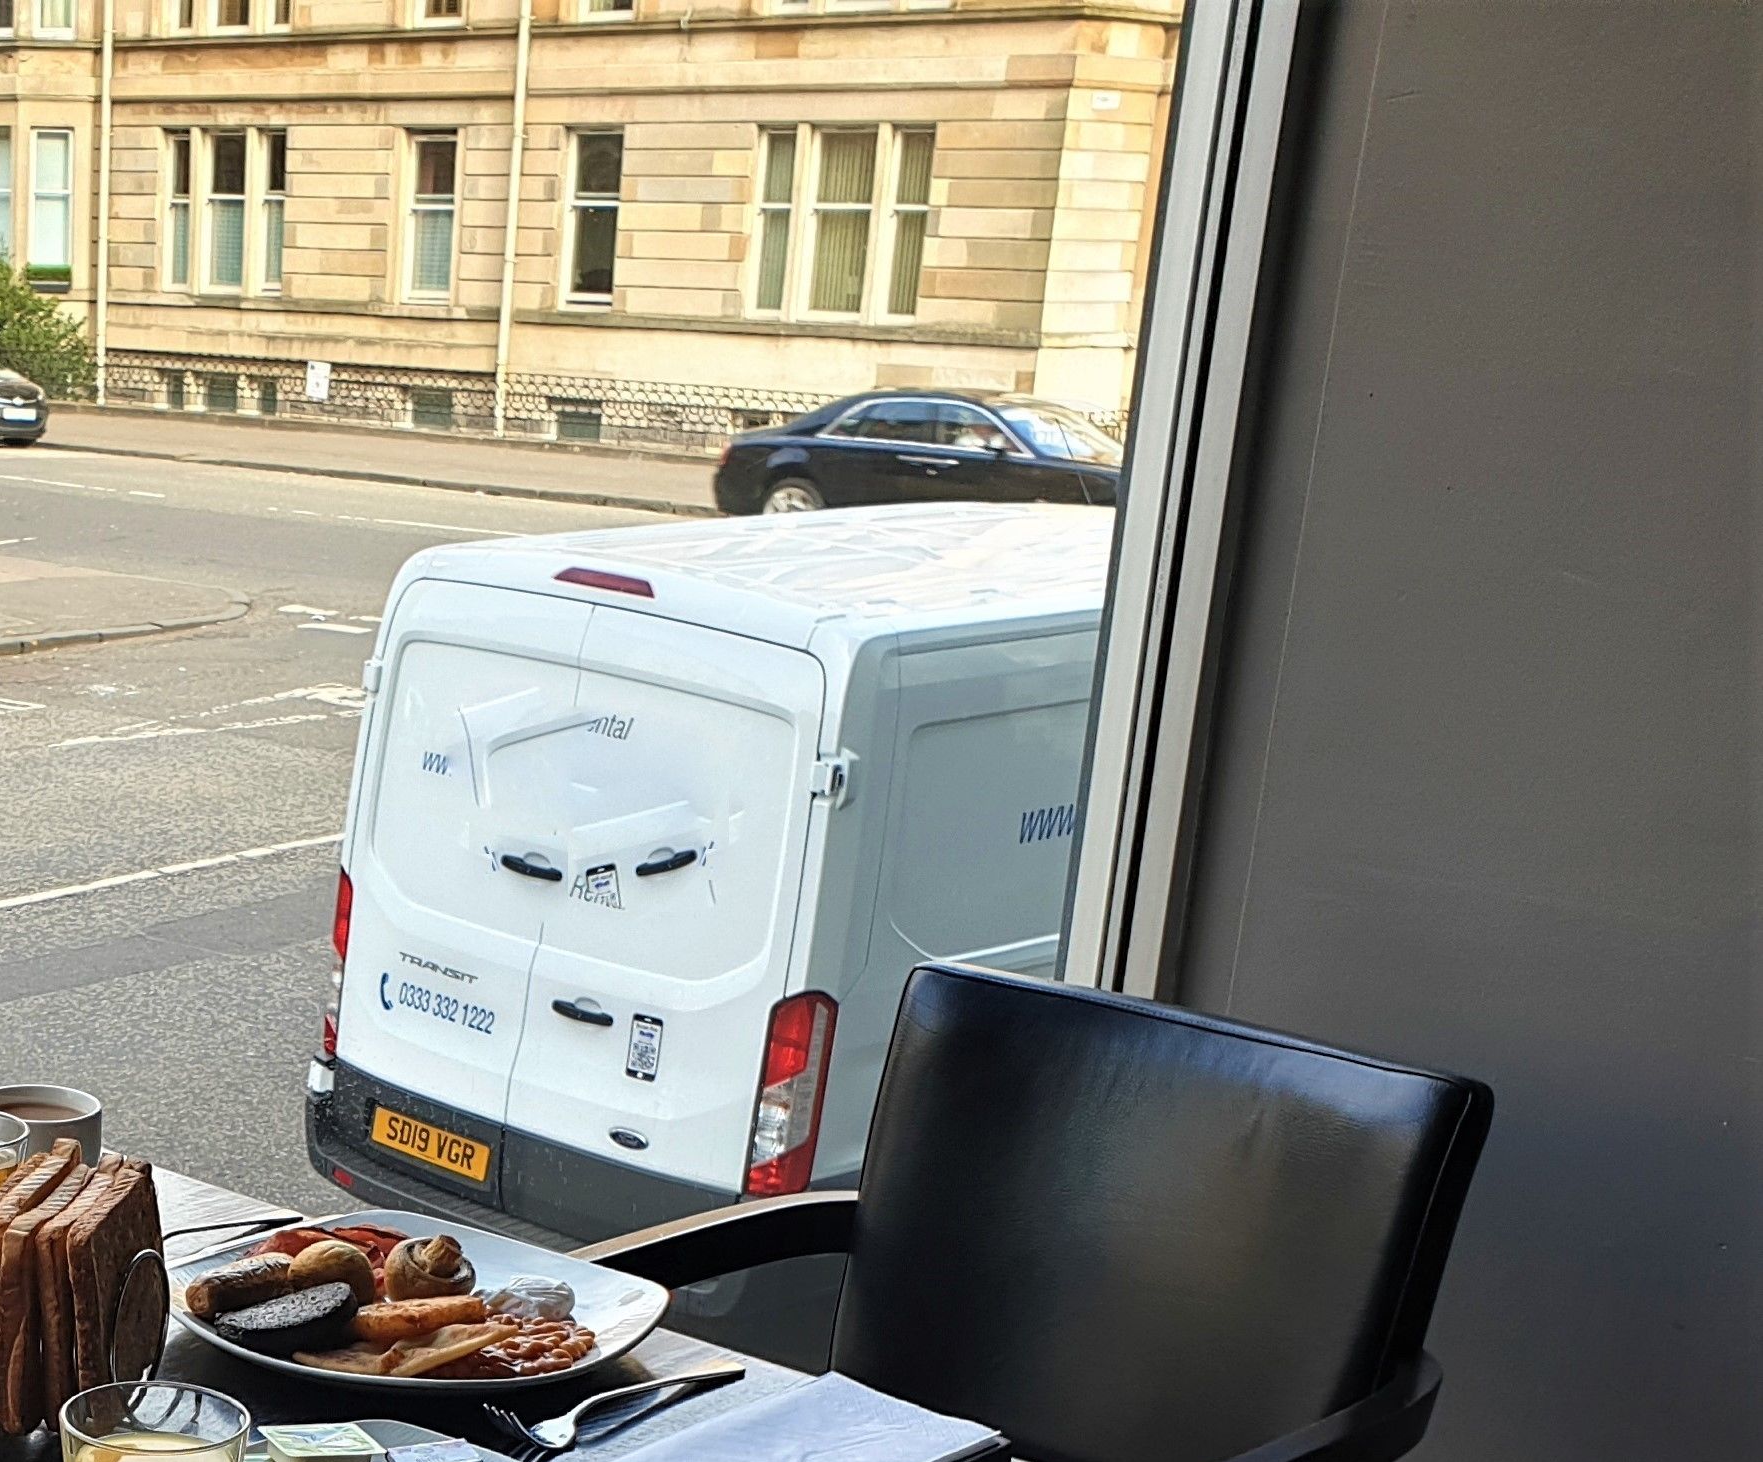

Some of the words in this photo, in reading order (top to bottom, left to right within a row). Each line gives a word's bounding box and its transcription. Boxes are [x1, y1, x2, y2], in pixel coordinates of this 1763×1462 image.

[399, 951, 479, 984] TRANSIT
[399, 982, 432, 1013] 0333
[432, 993, 459, 1023] 332
[461, 1003, 496, 1035] 1222
[386, 1116, 430, 1153] SD19
[437, 1132, 476, 1171] VGR
